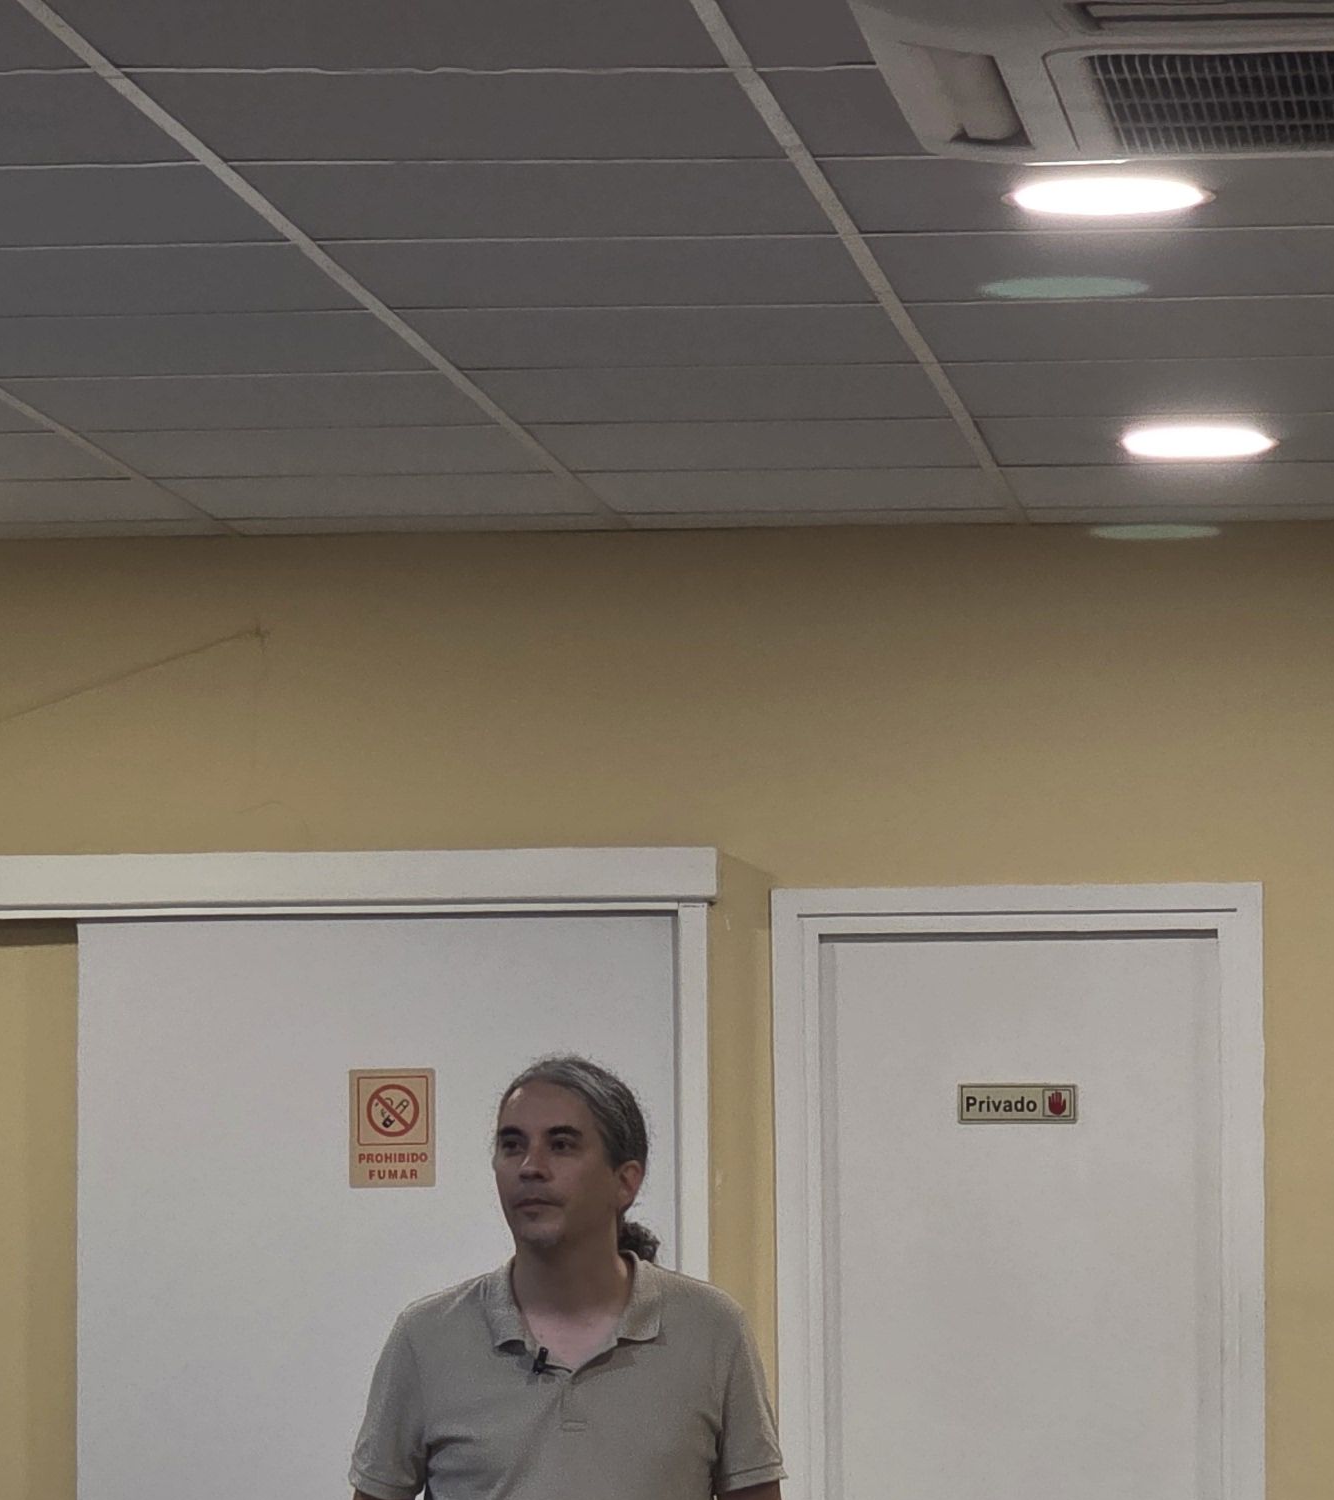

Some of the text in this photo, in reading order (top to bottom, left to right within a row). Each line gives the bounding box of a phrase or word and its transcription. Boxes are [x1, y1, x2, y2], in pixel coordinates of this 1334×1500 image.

[965, 1095, 1038, 1113] Privado
[358, 1151, 429, 1164] PROHIBIDO
[368, 1168, 419, 1180] FUMAR
